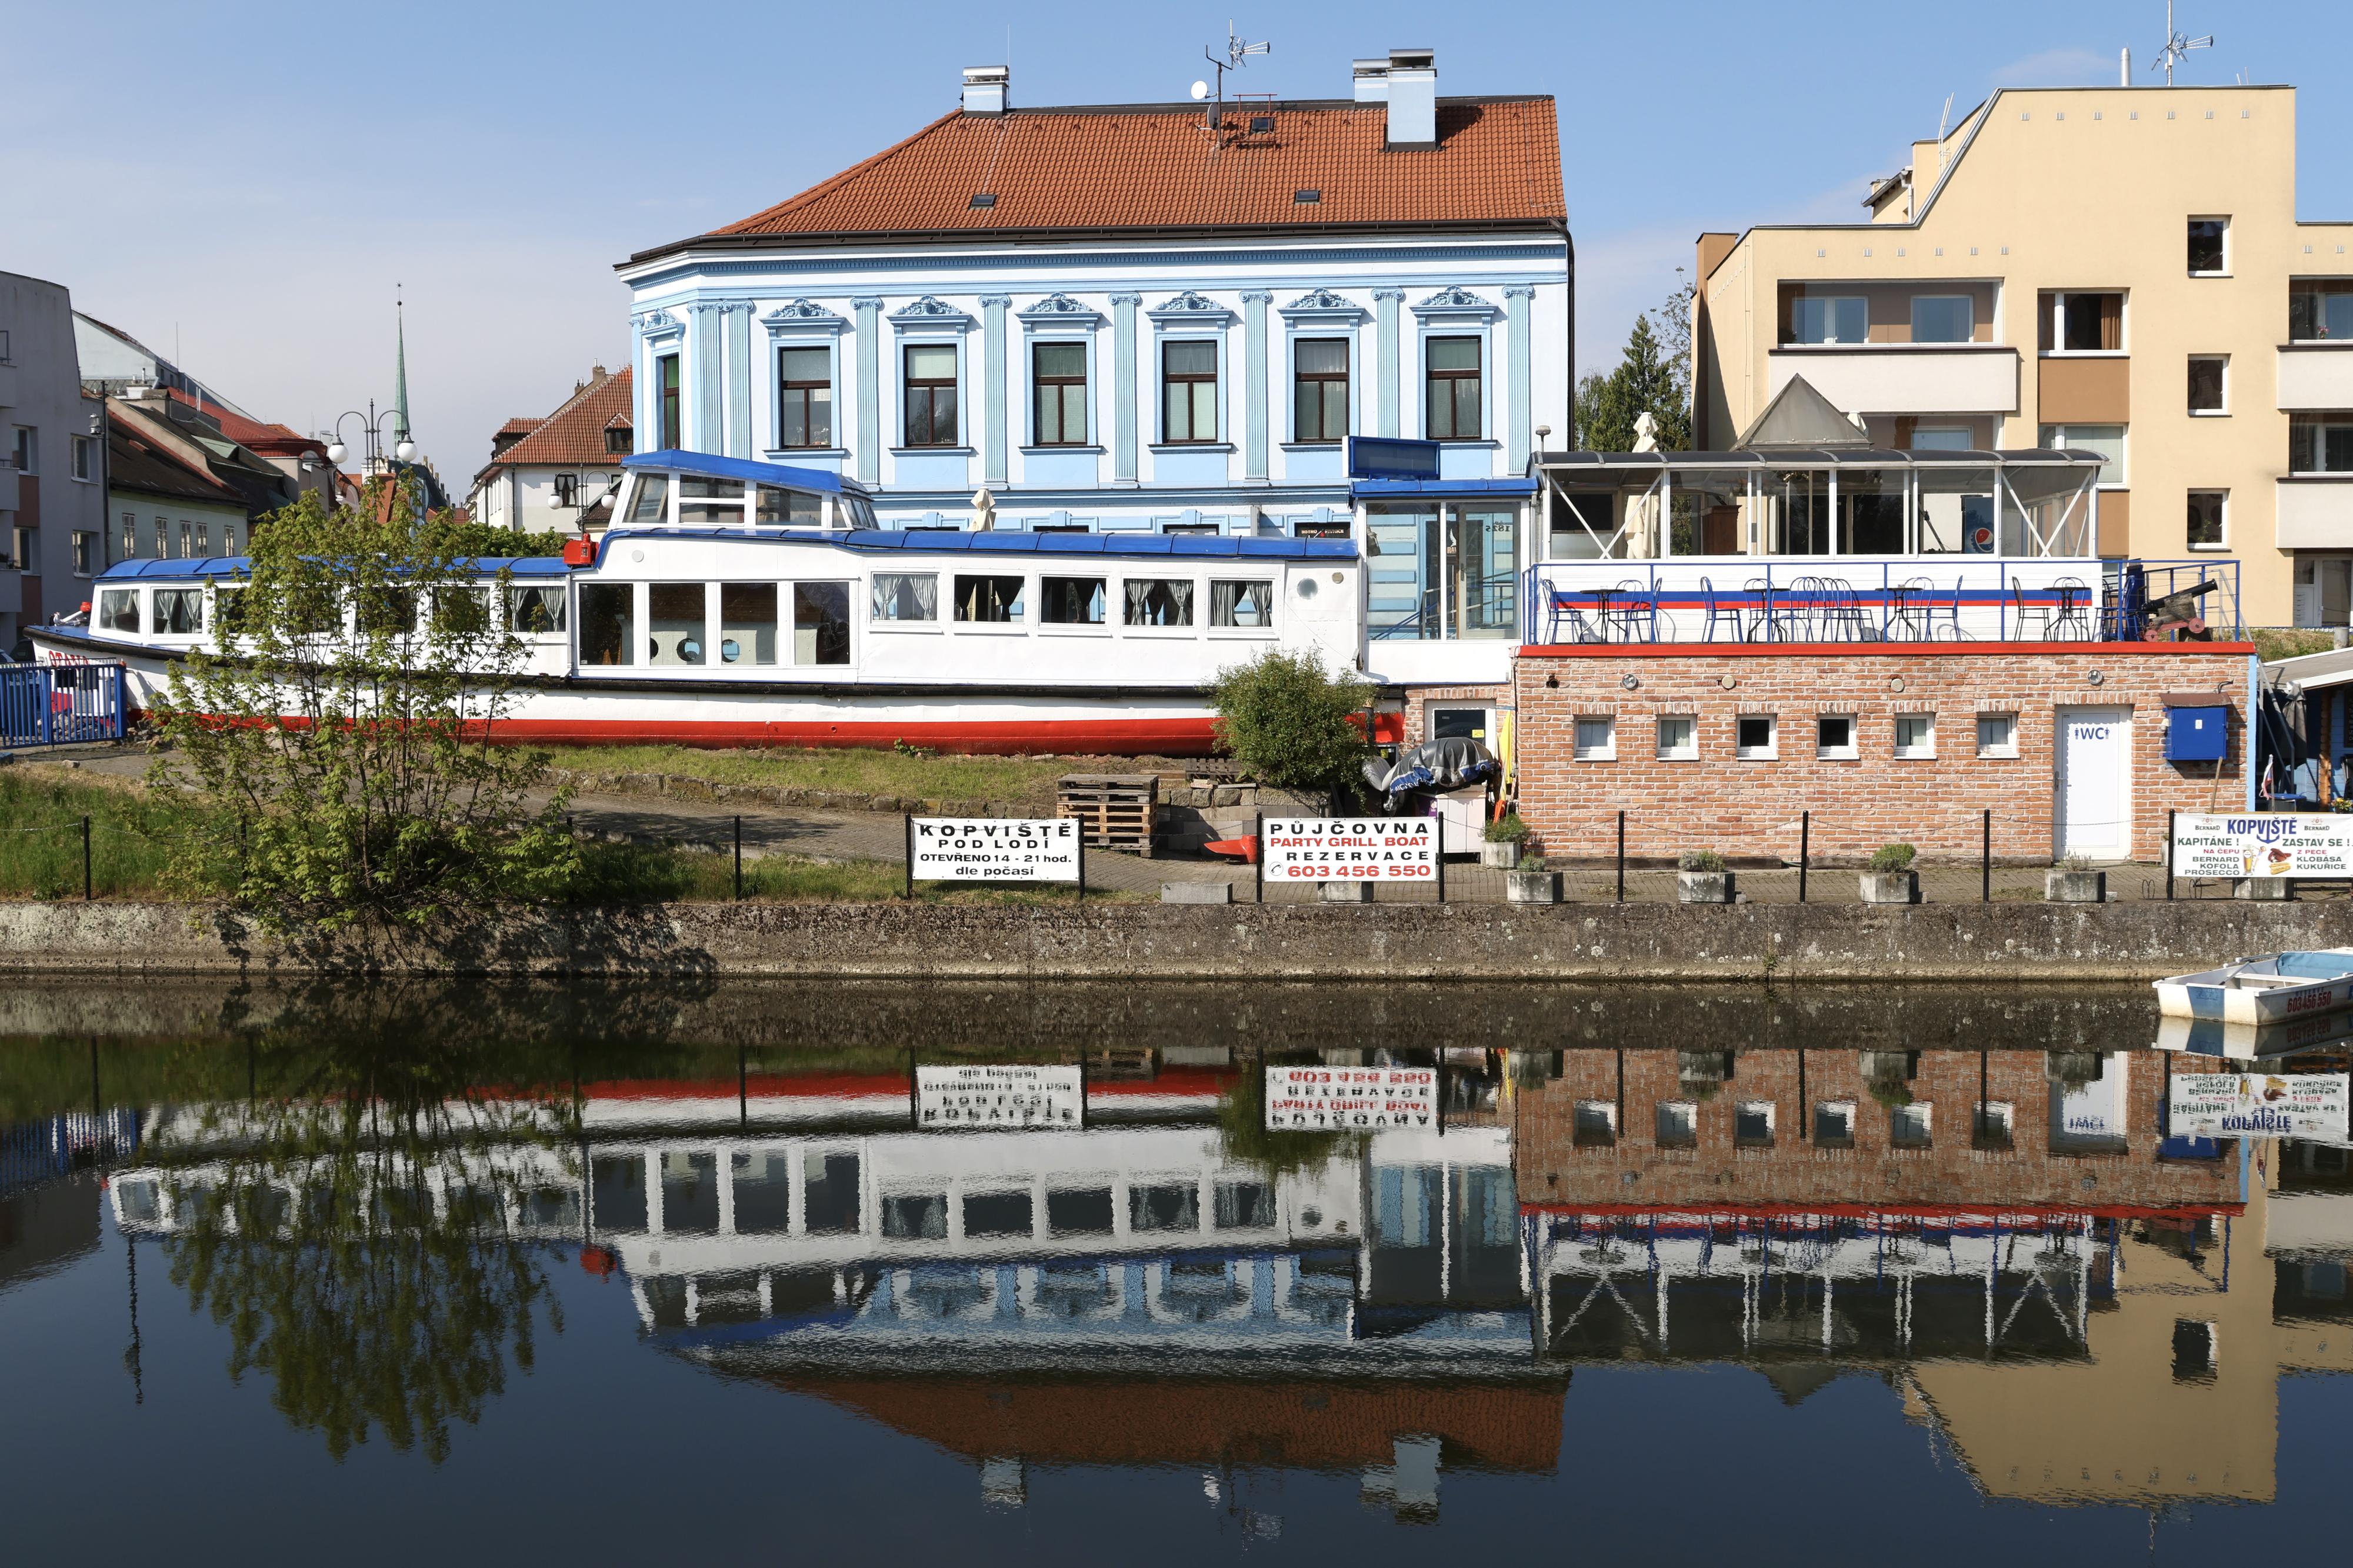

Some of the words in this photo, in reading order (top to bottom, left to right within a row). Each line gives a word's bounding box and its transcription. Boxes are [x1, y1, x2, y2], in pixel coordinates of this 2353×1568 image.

[2080, 727, 2104, 740] WC
[920, 823, 1071, 838] KOPVIŠTĚ
[1271, 820, 1428, 835] PŮJČOVNA
[2228, 816, 2298, 835] KOPVIŠTĚ
[939, 840, 983, 848] POD
[995, 838, 1048, 849] LODÍ
[1271, 838, 1323, 847] PARTY
[1328, 837, 1377, 846] GRILL
[1385, 836, 1429, 846] BOAT
[2178, 836, 2232, 846] KAPITÁNE
[920, 853, 991, 862] OTEVŘENO
[1287, 851, 1429, 861] REZERVACE
[956, 866, 978, 875] dle
[984, 866, 1034, 877] počasí
[1288, 866, 1330, 877] 603
[1336, 866, 1380, 877] 456
[1389, 865, 1431, 877] 550
[2287, 996, 2302, 1013] 603
[2302, 993, 2317, 1009] 456
[2318, 991, 2332, 1007] 550
